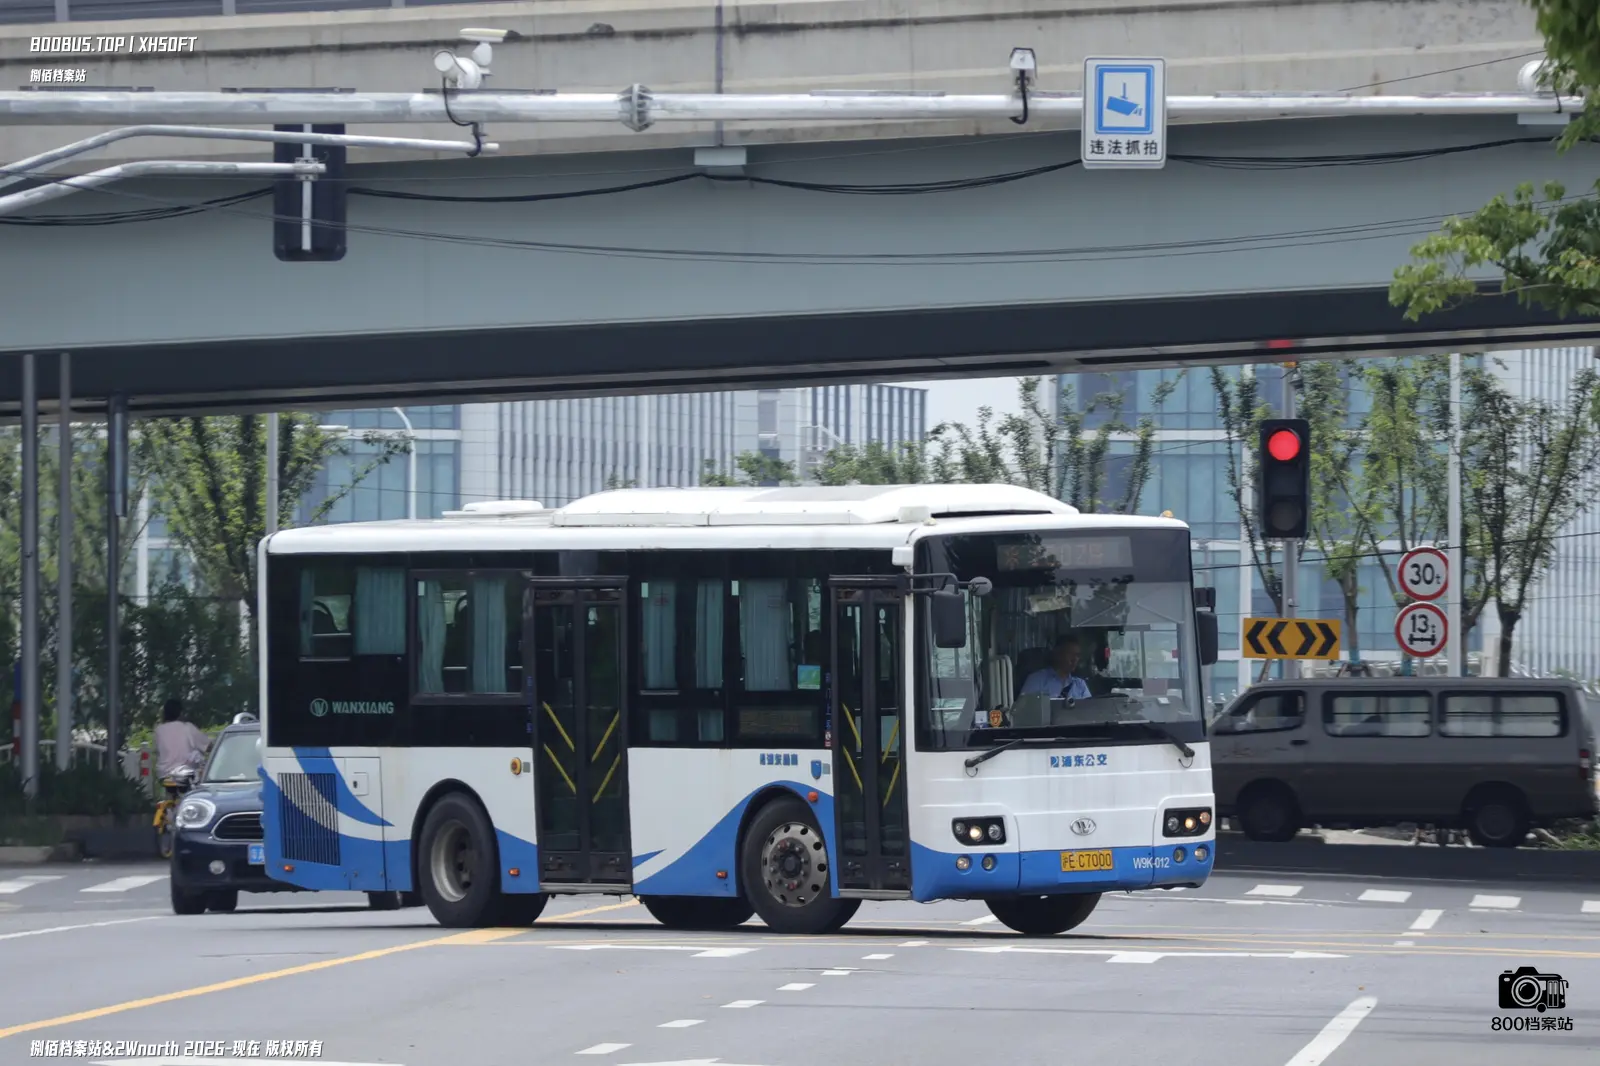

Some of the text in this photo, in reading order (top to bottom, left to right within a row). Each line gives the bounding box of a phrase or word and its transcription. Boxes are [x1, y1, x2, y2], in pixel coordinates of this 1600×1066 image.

[1090, 139, 1158, 155] 违法抓拍
[332, 701, 395, 714] WANXIANG
[1061, 753, 1107, 768] 浦东公交
[1133, 857, 1170, 870] W9K-012
